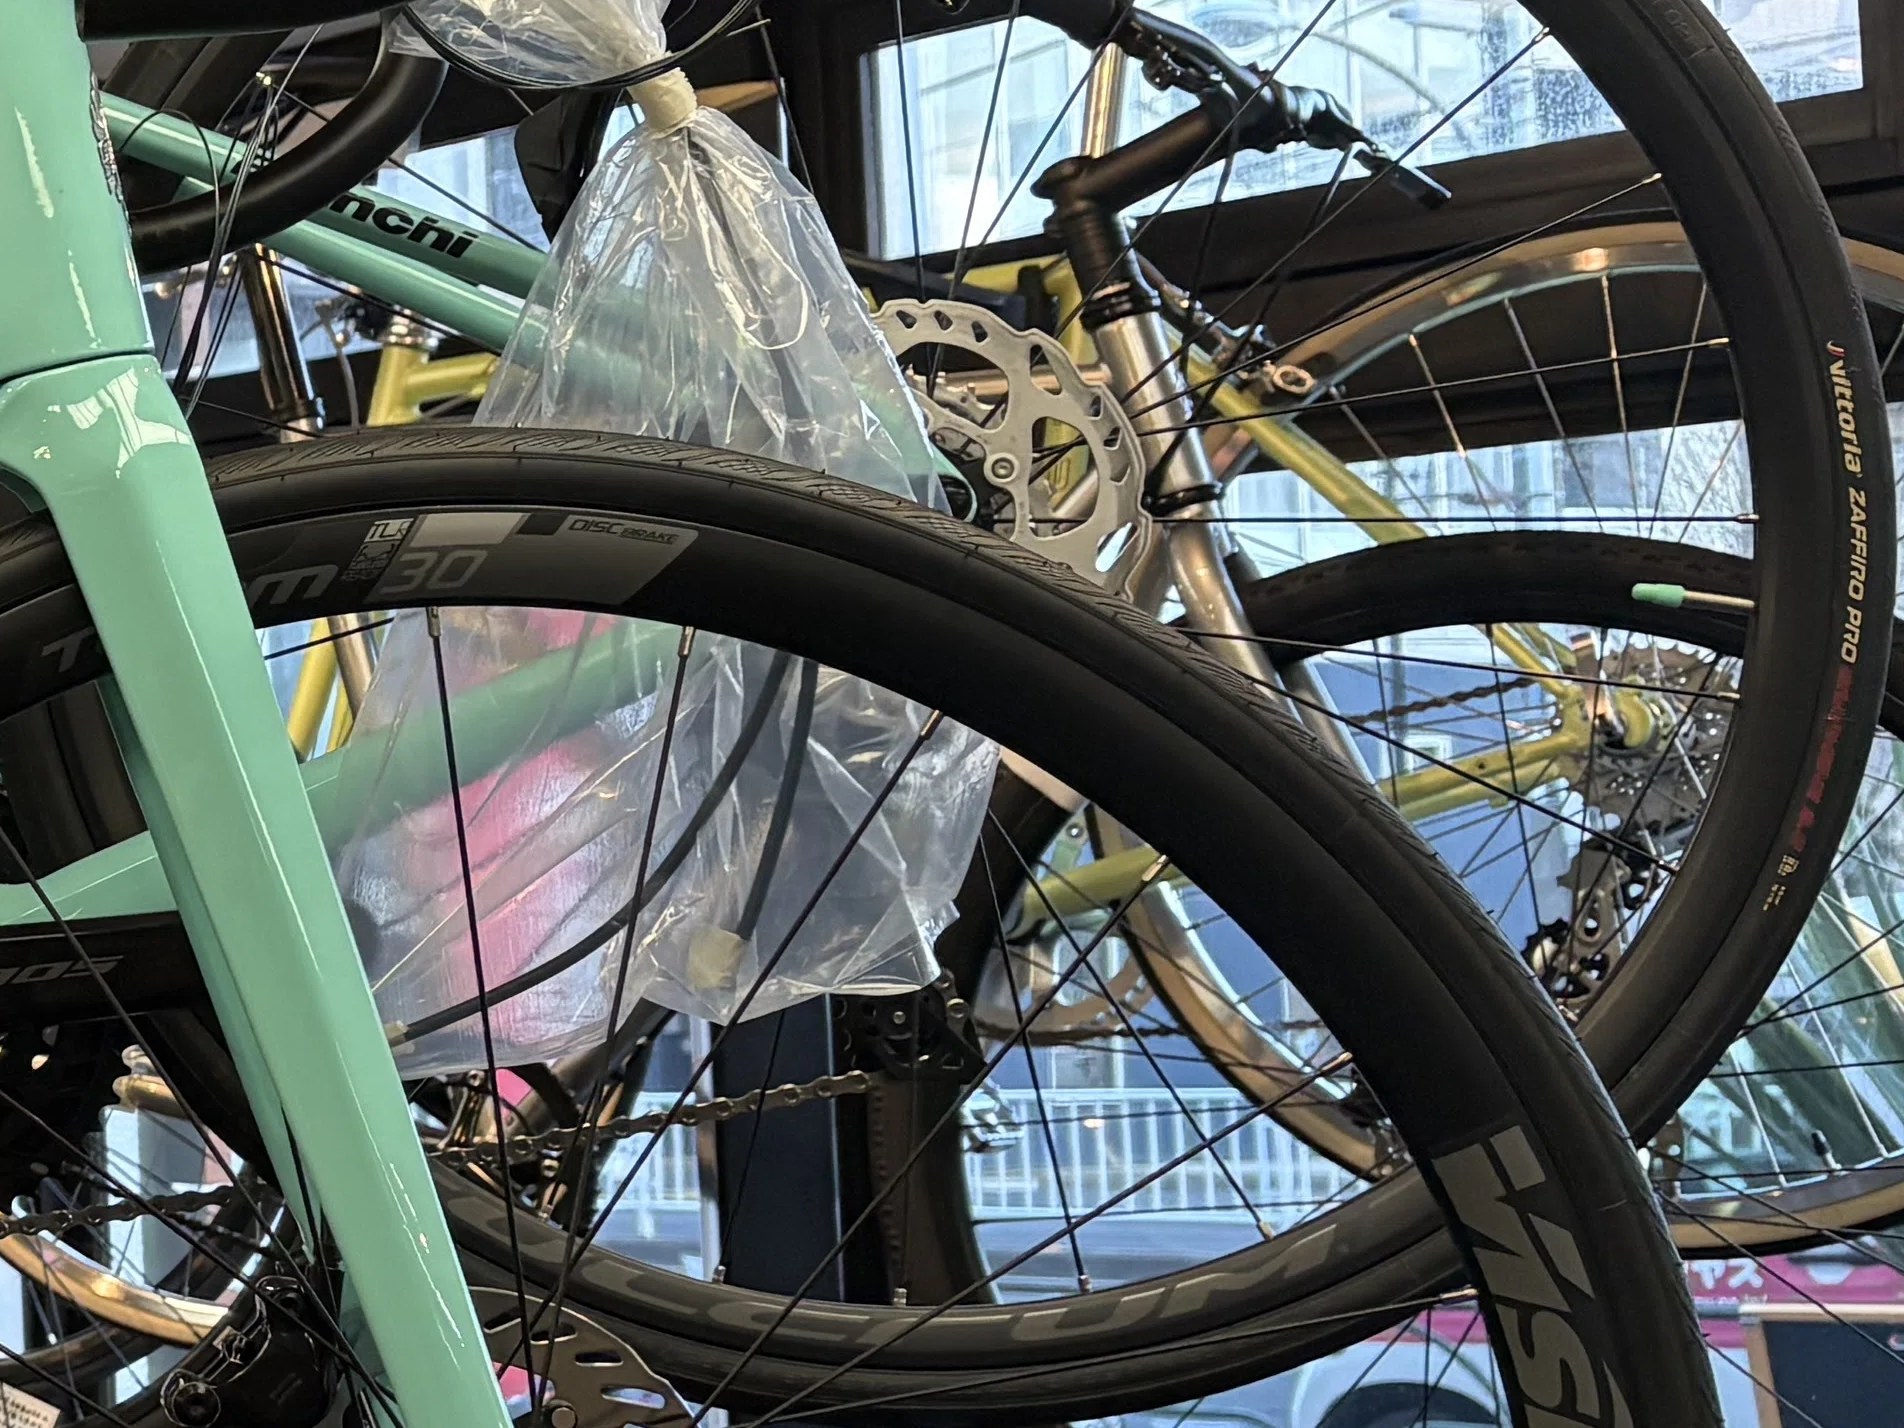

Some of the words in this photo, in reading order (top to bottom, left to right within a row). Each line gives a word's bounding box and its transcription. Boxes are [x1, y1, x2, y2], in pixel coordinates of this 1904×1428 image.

[567, 518, 620, 535] DISC
[620, 525, 681, 545] BRAKE
[1848, 486, 1868, 602] ZAFFIRO
[379, 549, 489, 595] 30
[1841, 612, 1863, 665] PRO
